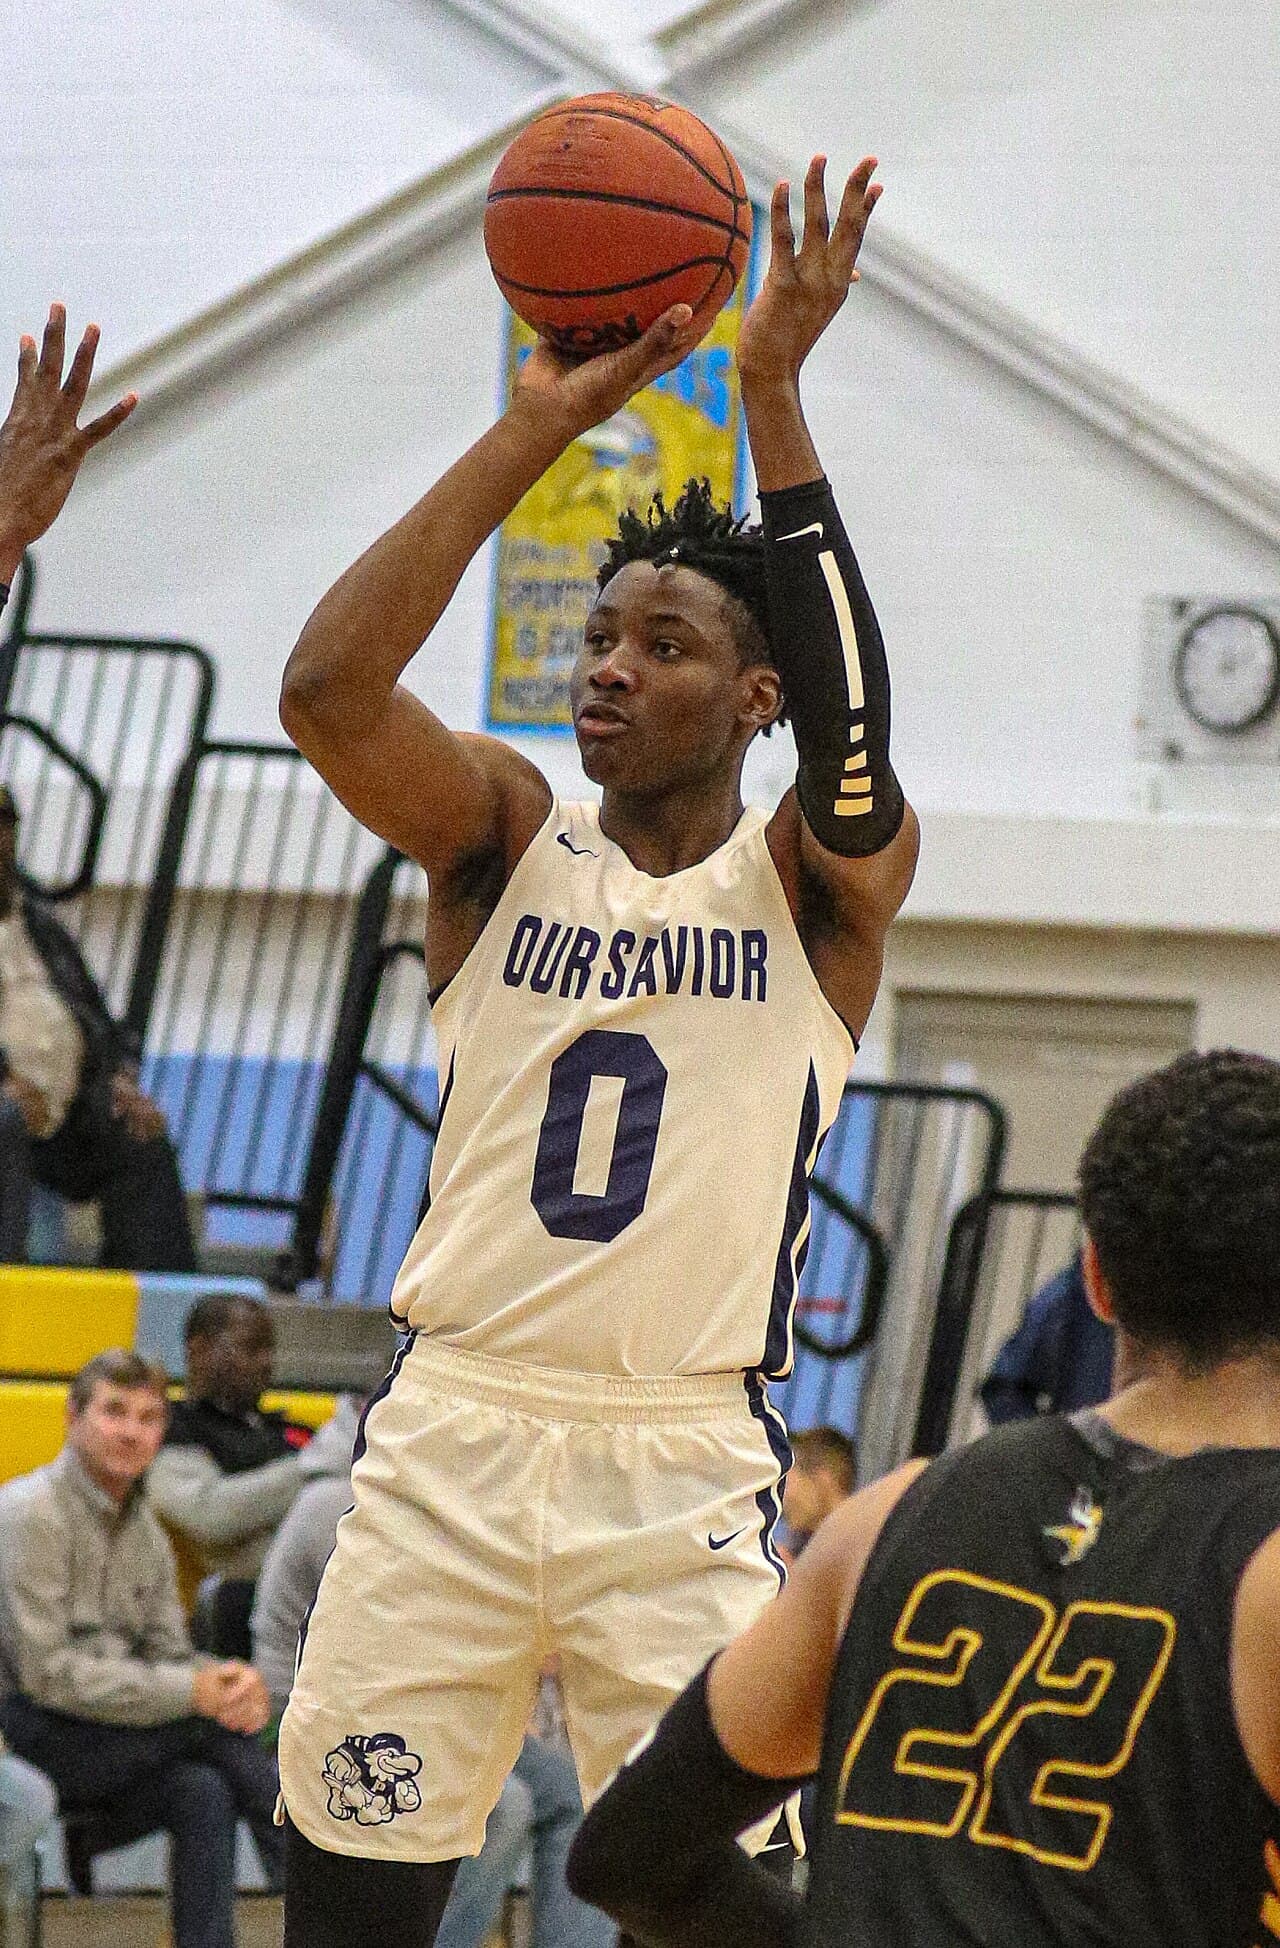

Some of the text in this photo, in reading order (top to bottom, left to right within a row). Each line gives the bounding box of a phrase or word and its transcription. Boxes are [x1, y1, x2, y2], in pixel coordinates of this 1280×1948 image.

[502, 914, 767, 1002] OUR SAVIOR
[530, 1029, 668, 1243] 0
[835, 1567, 1177, 1872] 22
